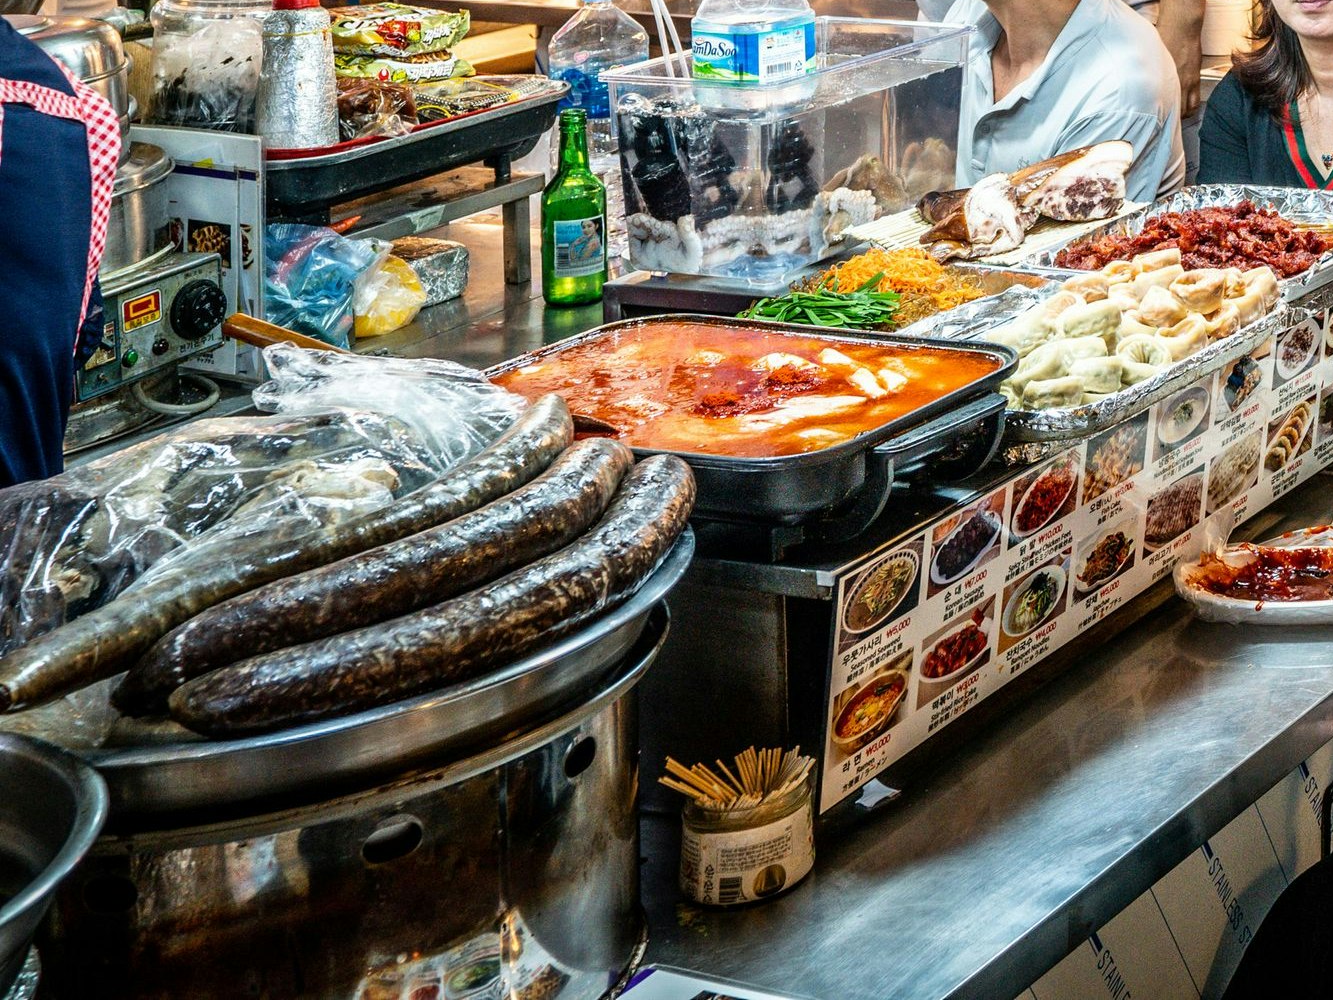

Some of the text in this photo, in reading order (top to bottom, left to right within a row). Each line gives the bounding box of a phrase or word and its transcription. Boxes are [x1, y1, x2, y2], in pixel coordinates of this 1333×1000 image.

[1042, 534, 1060, 551] Chicken
[1061, 528, 1071, 540] Feet
[964, 567, 987, 591] ₩7,000
[1099, 578, 1119, 598] ₩5,000
[945, 581, 983, 612] Korean Sausage
[886, 615, 911, 639] ₩5,000
[850, 634, 900, 672] Seasoned Seaweed
[1006, 620, 1056, 662] 잔치국수 ₩4,000
[1010, 633, 1049, 666] Banquet Noodles
[953, 693, 963, 706] Rice
[964, 685, 976, 699] Cake
[865, 732, 891, 758] ₩3,000
[856, 756, 874, 774] Ramen
[1208, 857, 1243, 931] STAINLESS
